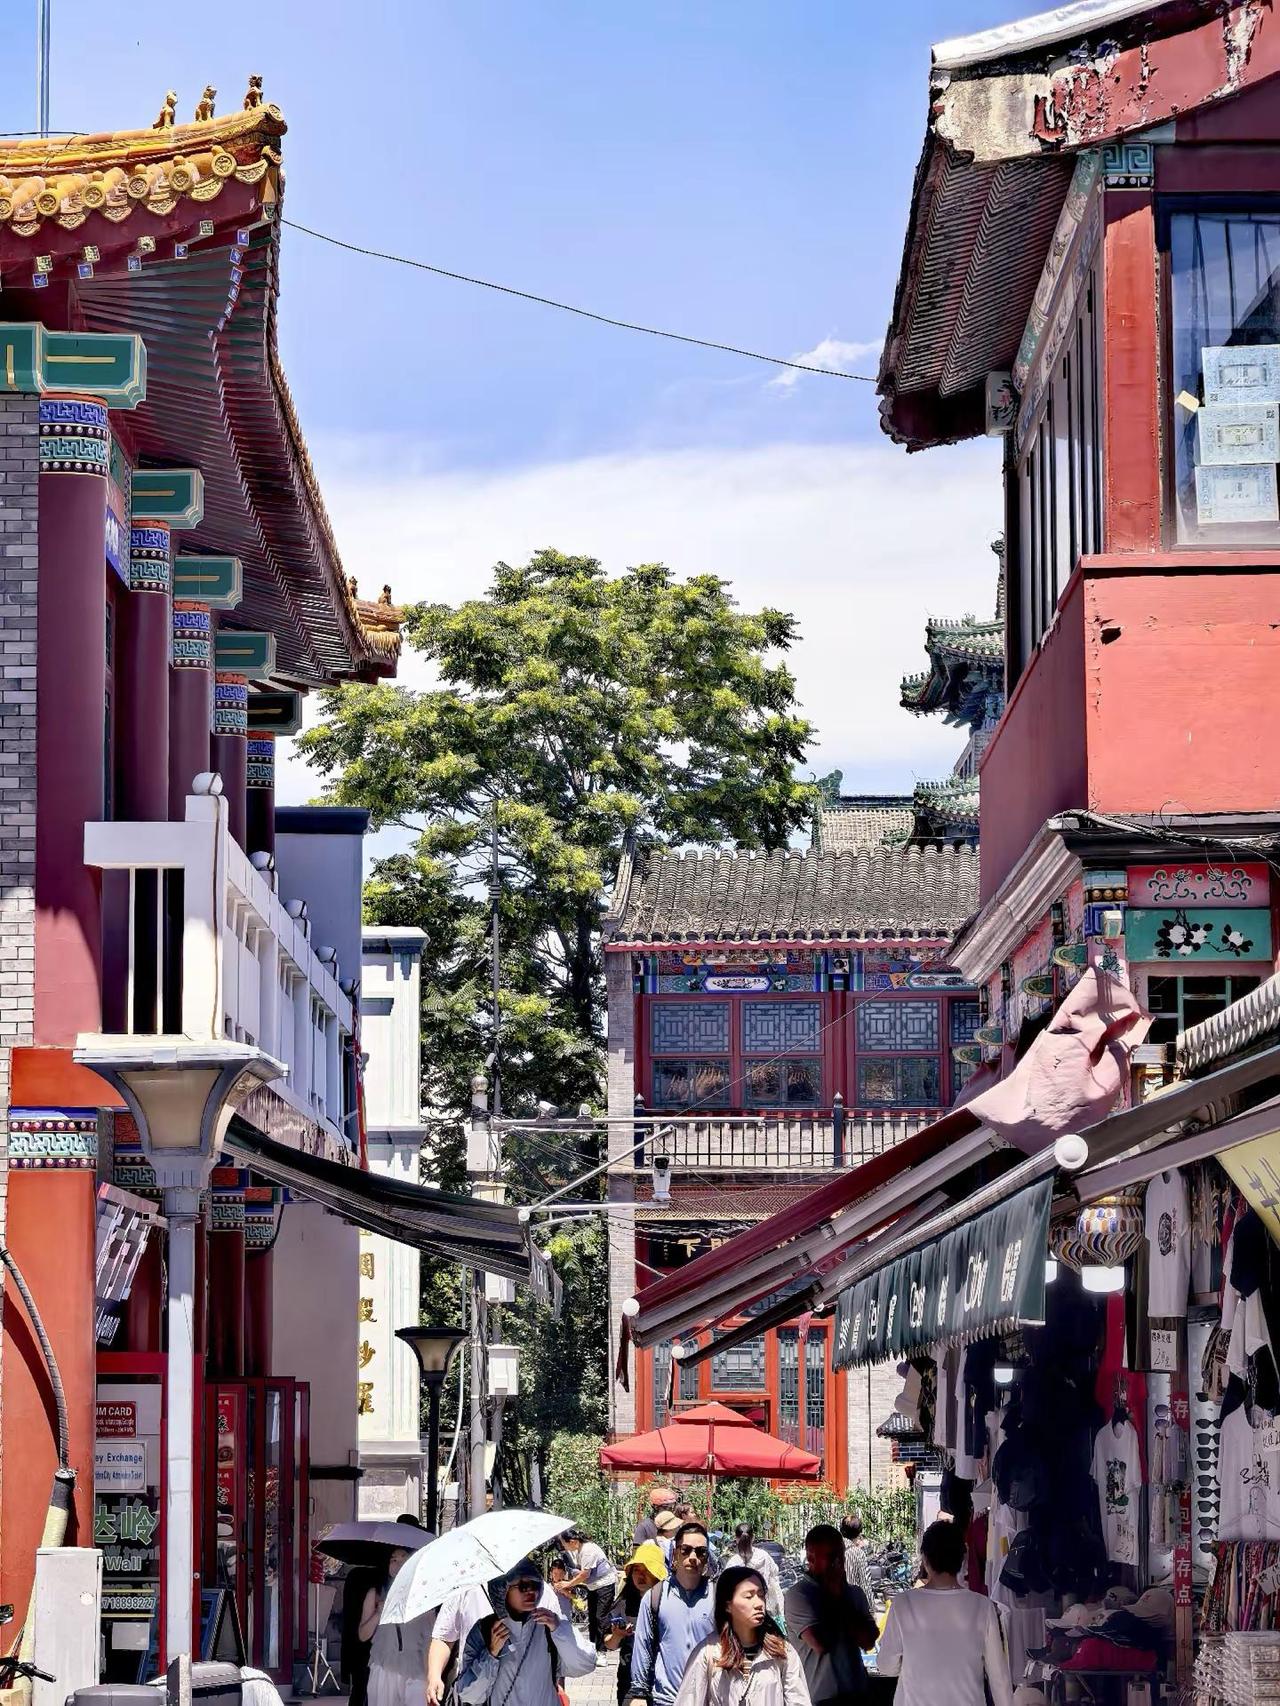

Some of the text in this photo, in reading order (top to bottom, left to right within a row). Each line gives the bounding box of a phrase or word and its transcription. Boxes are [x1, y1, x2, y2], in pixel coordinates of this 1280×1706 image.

[96, 1407, 132, 1416] IM CARD
[95, 1453, 142, 1464] ey Exchange
[95, 1506, 156, 1545] 达岭
[105, 1556, 141, 1571] Wall
[101, 1597, 156, 1609] 718898227
